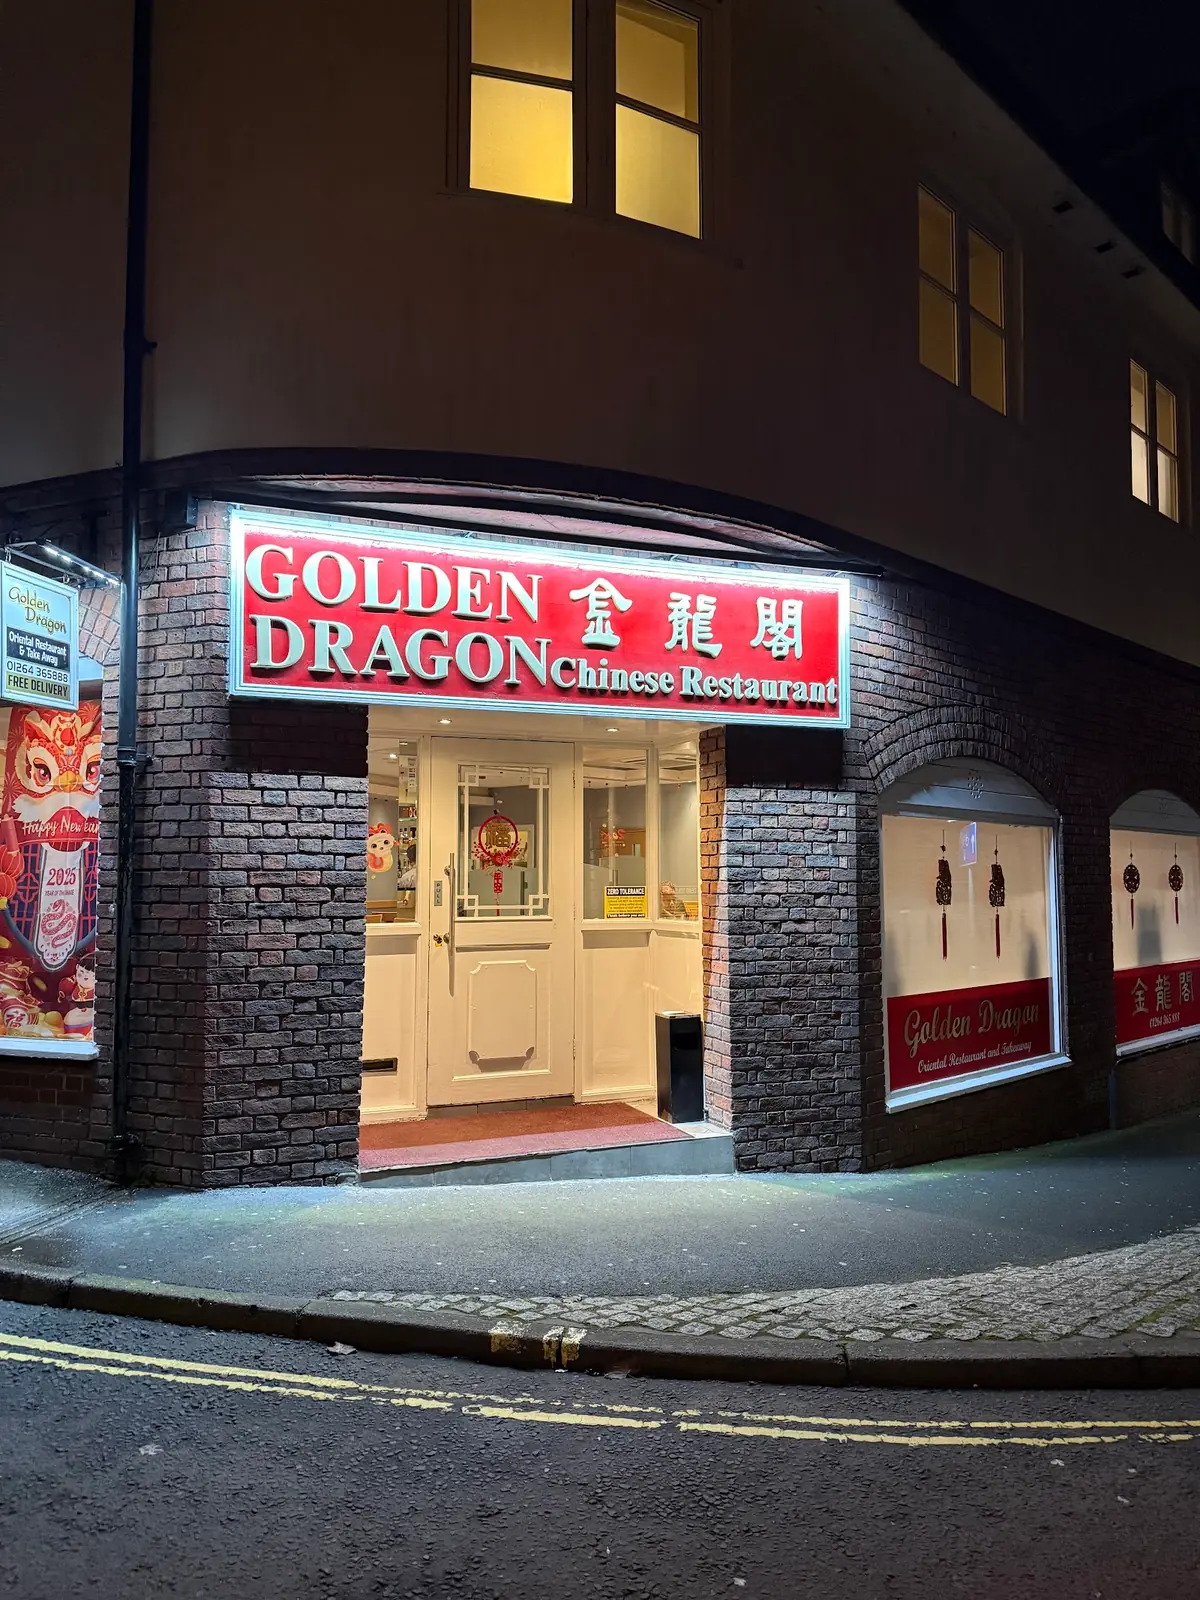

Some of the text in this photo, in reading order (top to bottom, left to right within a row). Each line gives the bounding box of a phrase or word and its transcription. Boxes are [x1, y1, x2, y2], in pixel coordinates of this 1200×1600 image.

[246, 544, 543, 622] GOLDEN
[9, 587, 50, 613] Golden
[25, 606, 67, 634] Dragon
[569, 577, 804, 660] 金龍閣
[9, 631, 67, 656] Oriental Restaurant
[19, 645, 58, 666] & Take Away
[248, 614, 552, 687] DRAGON
[7, 661, 69, 682] 01264 365888
[8, 675, 68, 696] FREE DELIVERY
[551, 657, 838, 705] Chinese Restaurant
[22, 820, 58, 837] Happy
[60, 814, 82, 833] New
[47, 867, 76, 886] 2025
[1130, 971, 1194, 1016] 金龍閣
[904, 999, 1039, 1058] Golden Dragon
[918, 1041, 1032, 1074] Oriental Restaurant and Takeaway
